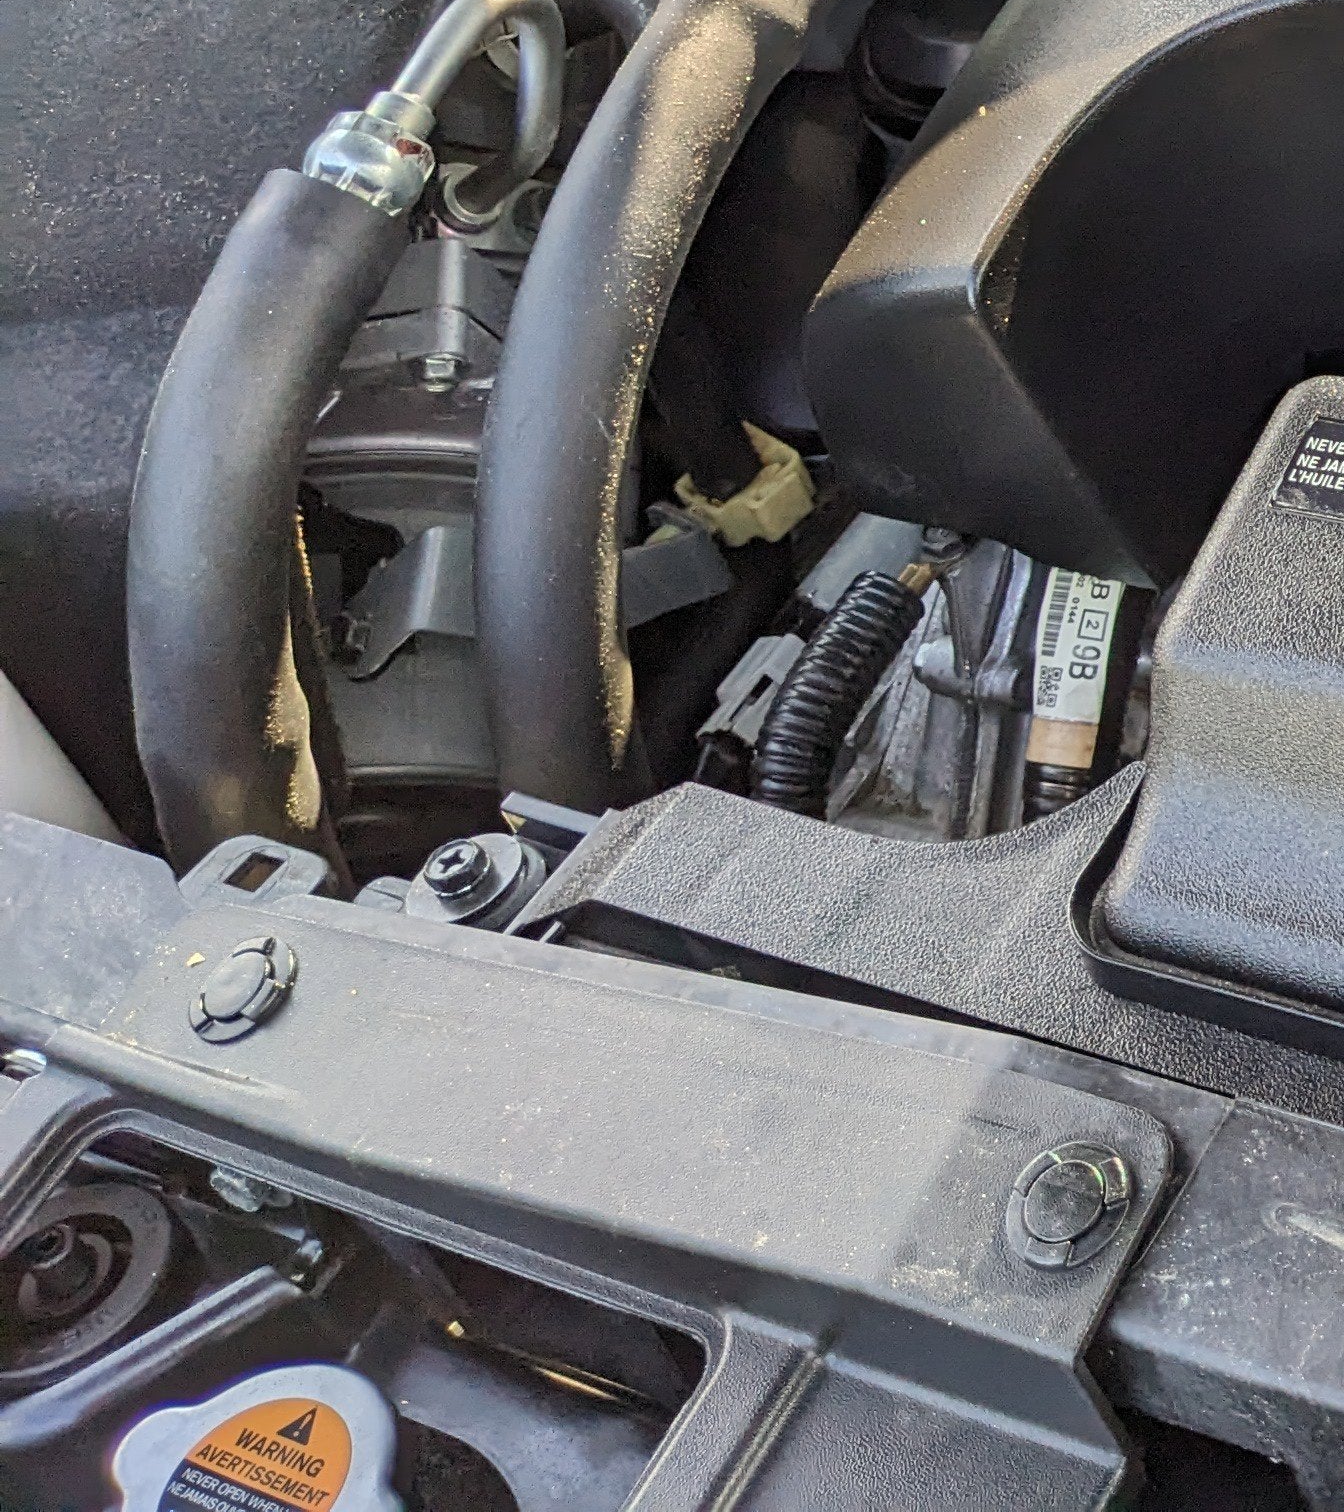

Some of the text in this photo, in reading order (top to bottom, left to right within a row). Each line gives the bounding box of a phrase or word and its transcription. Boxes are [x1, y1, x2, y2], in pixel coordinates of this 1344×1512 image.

[1296, 454, 1319, 469] NE
[1086, 619, 1100, 630] 2
[1068, 644, 1101, 680] 9B
[235, 1428, 325, 1478] WARNING
[181, 1467, 221, 1491] NEVER
[218, 1483, 250, 1504] OPEN
[196, 1443, 330, 1506] AVERTISSEMENT
[167, 1480, 184, 1496] NE
[180, 1487, 218, 1511] JAMAIS
